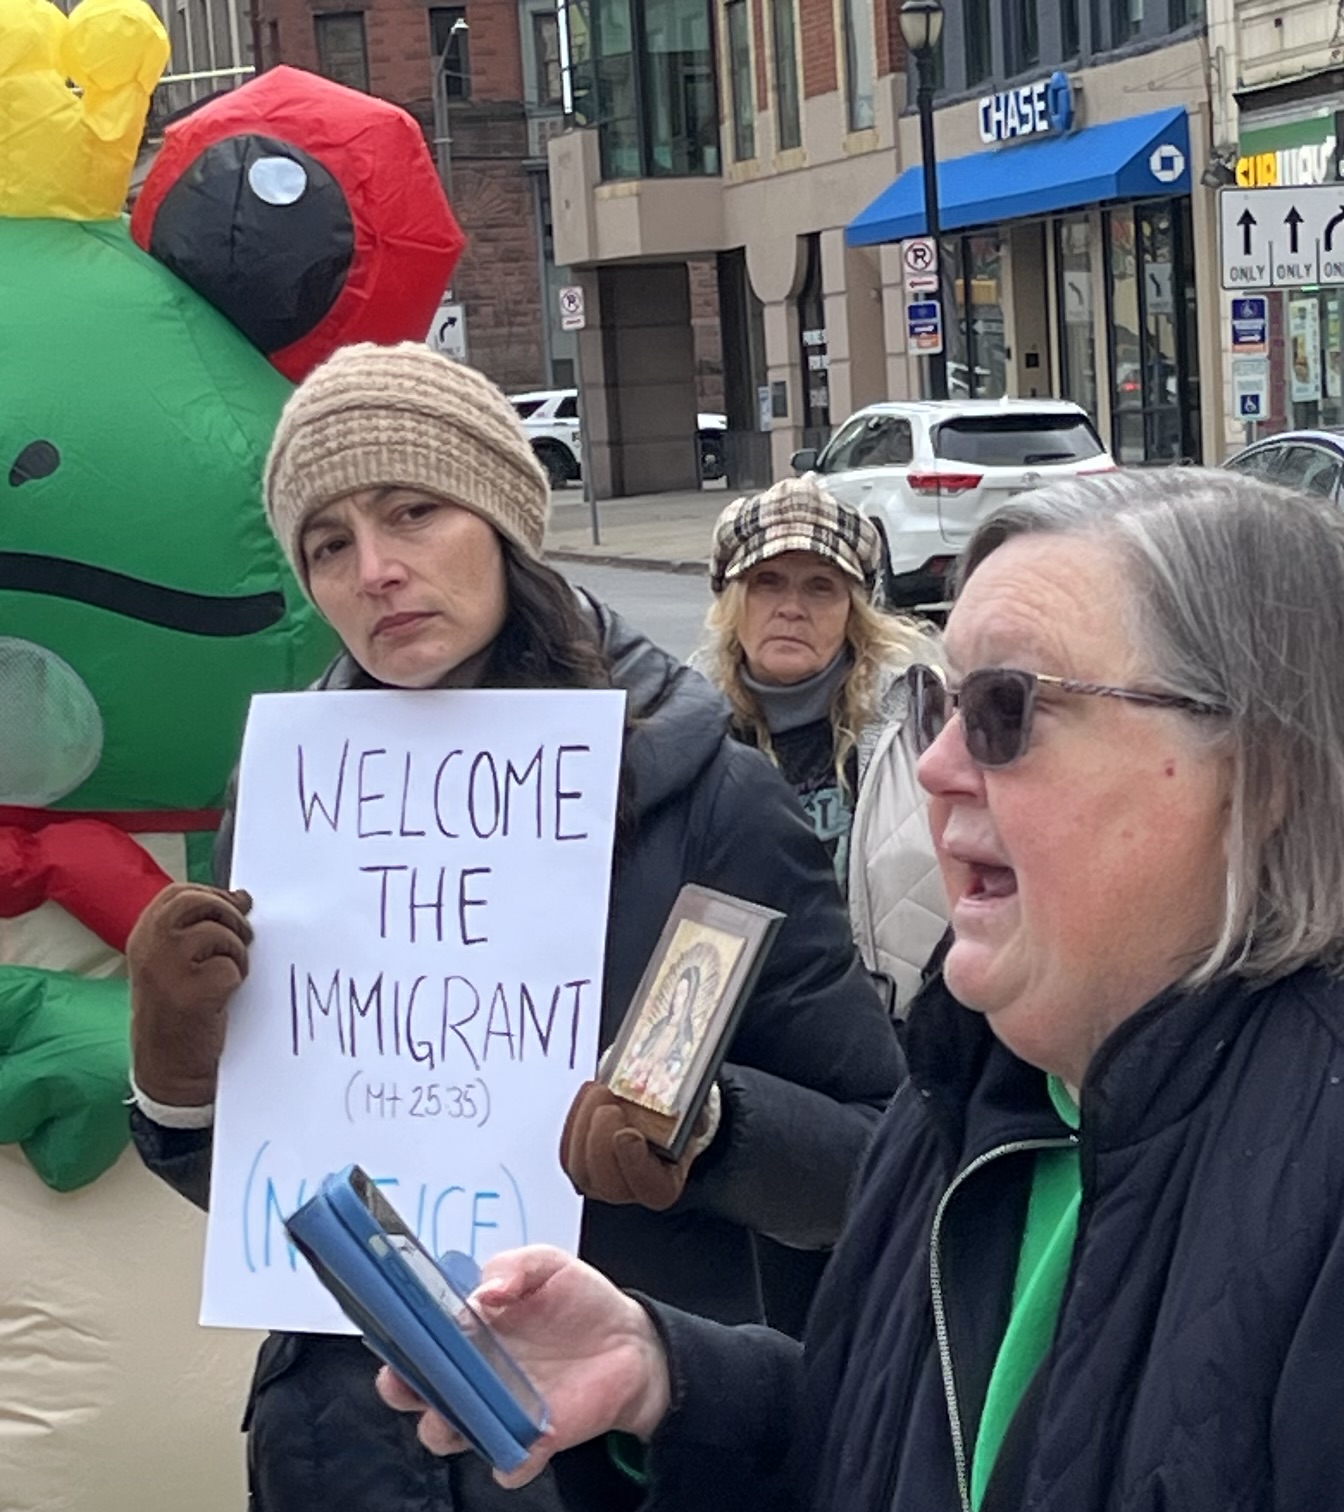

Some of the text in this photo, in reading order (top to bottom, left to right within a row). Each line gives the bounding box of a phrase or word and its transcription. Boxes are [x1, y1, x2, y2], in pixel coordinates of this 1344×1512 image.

[979, 82, 1049, 144] CHASE
[1230, 264, 1265, 282] ONLY
[1276, 263, 1312, 281] ONLY
[297, 740, 591, 841] WELCOME
[360, 865, 492, 944] THE
[290, 963, 592, 1070] IMMIGRANT
